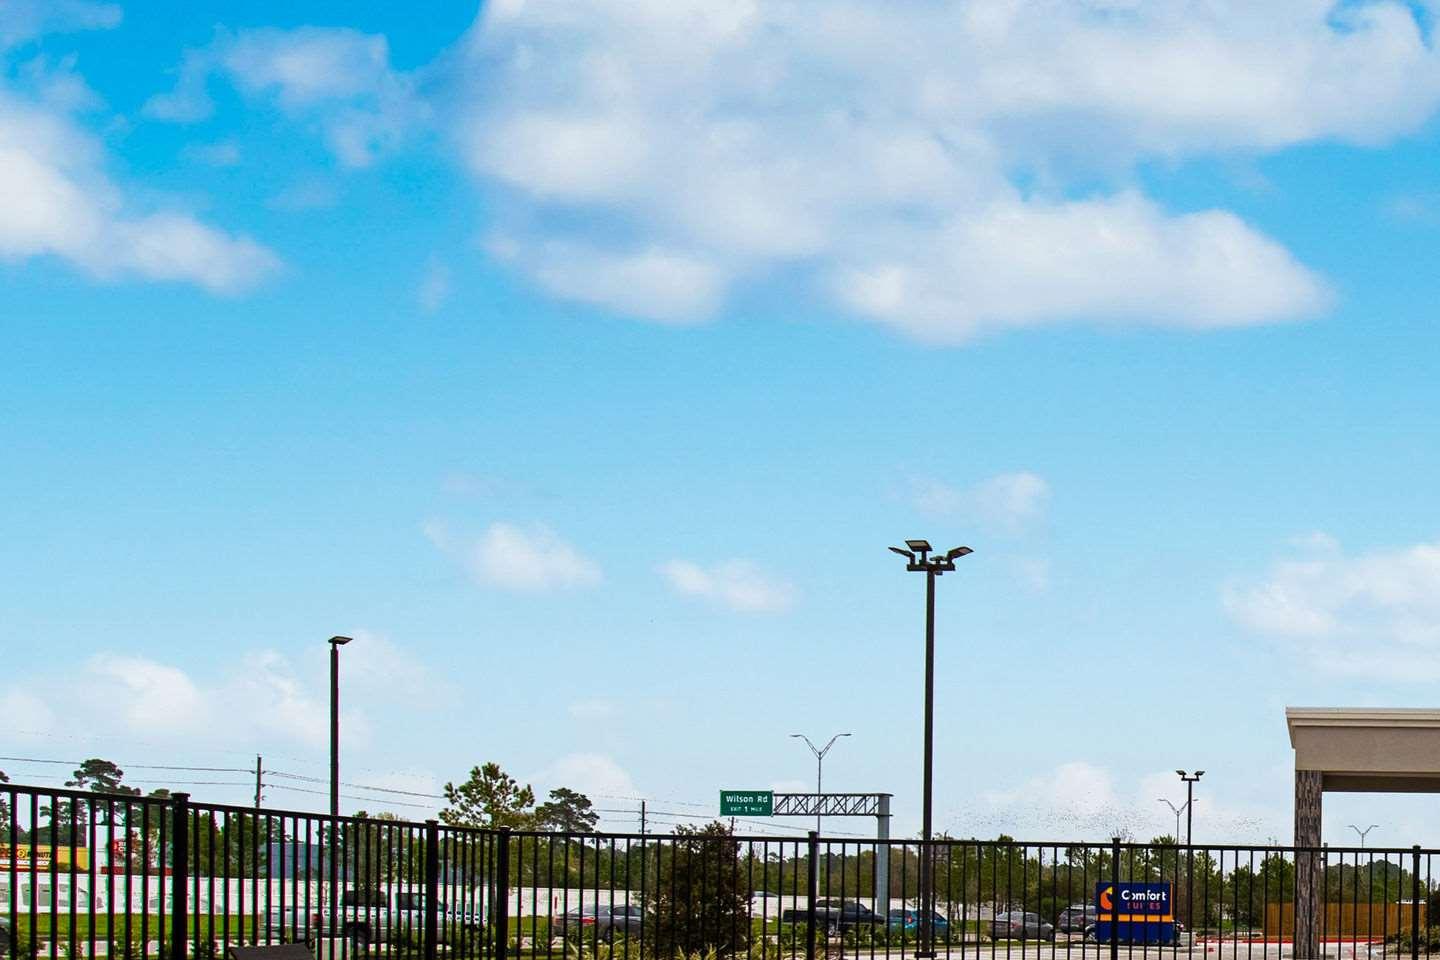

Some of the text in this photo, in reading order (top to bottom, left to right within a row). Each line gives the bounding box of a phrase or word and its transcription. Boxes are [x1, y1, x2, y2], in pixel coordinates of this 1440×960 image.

[726, 795, 768, 803] Wilson Rd
[1121, 889, 1167, 901] Comfort
[1127, 902, 1161, 910] UIES
